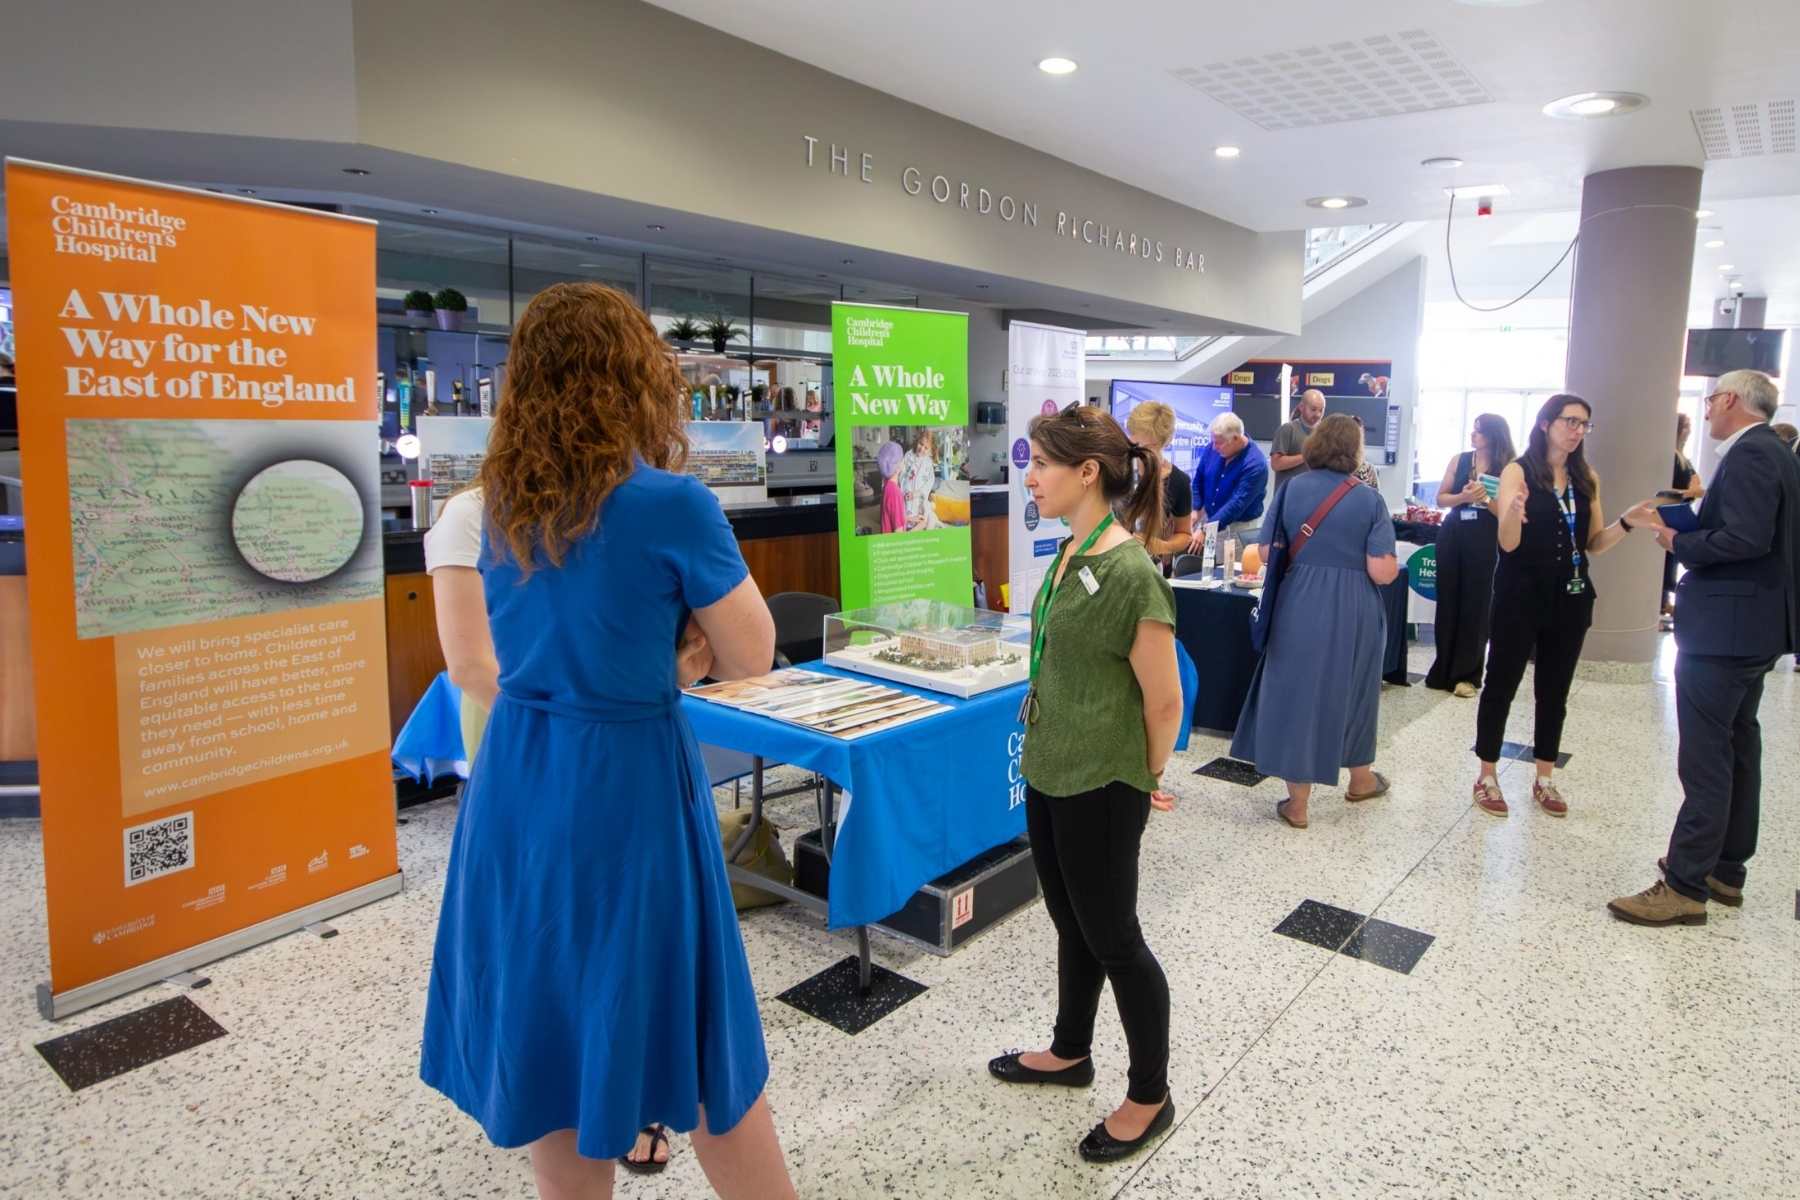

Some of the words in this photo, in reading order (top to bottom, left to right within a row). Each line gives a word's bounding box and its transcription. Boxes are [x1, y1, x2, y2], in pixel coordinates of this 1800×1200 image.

[51, 195, 187, 233] Cambridge
[804, 136, 873, 183] THE
[903, 167, 1038, 226] GORDON
[1056, 212, 1163, 262] RICHARDS
[1175, 246, 1206, 273] BAR
[51, 216, 177, 248] Children's
[54, 235, 157, 263] Hospital
[58, 288, 94, 320] A
[98, 291, 235, 330] Whole
[240, 304, 317, 337] New
[847, 317, 894, 332] Cambridge
[59, 327, 156, 368] Way
[163, 333, 222, 364] for
[227, 338, 287, 368] the
[848, 336, 884, 348] Hospital
[64, 366, 160, 397] East
[165, 371, 209, 398] of
[209, 373, 356, 407] England
[849, 368, 868, 388] A
[872, 365, 945, 389] Whole
[851, 392, 902, 416] New
[904, 394, 951, 420] Way
[137, 645, 166, 659] We
[168, 640, 196, 655] will
[200, 635, 240, 649] bring
[244, 623, 315, 643] specialist
[318, 619, 349, 631] care
[138, 658, 191, 676] closer
[195, 656, 210, 668] to
[214, 648, 262, 663] home.
[265, 637, 328, 653] Children
[329, 630, 356, 644] and
[140, 673, 206, 693] families
[208, 663, 260, 680] across
[263, 658, 289, 670] the
[292, 651, 324, 665] East
[327, 645, 342, 658] of
[141, 685, 208, 709] England
[212, 679, 239, 695] will
[241, 675, 278, 689] have
[281, 666, 329, 682] better,
[331, 659, 367, 673] more
[140, 702, 218, 726] equitable
[222, 690, 277, 709] access
[279, 687, 295, 698] to
[298, 681, 321, 694] the
[324, 676, 354, 689] care
[140, 726, 178, 743] they
[181, 715, 223, 733] need
[247, 703, 279, 720] with
[281, 700, 313, 713] less
[315, 691, 346, 705] time
[141, 741, 186, 759] away
[190, 731, 226, 748] from
[230, 718, 286, 739] school,
[288, 709, 329, 727] home
[331, 701, 358, 717] and
[142, 746, 237, 775] community.
